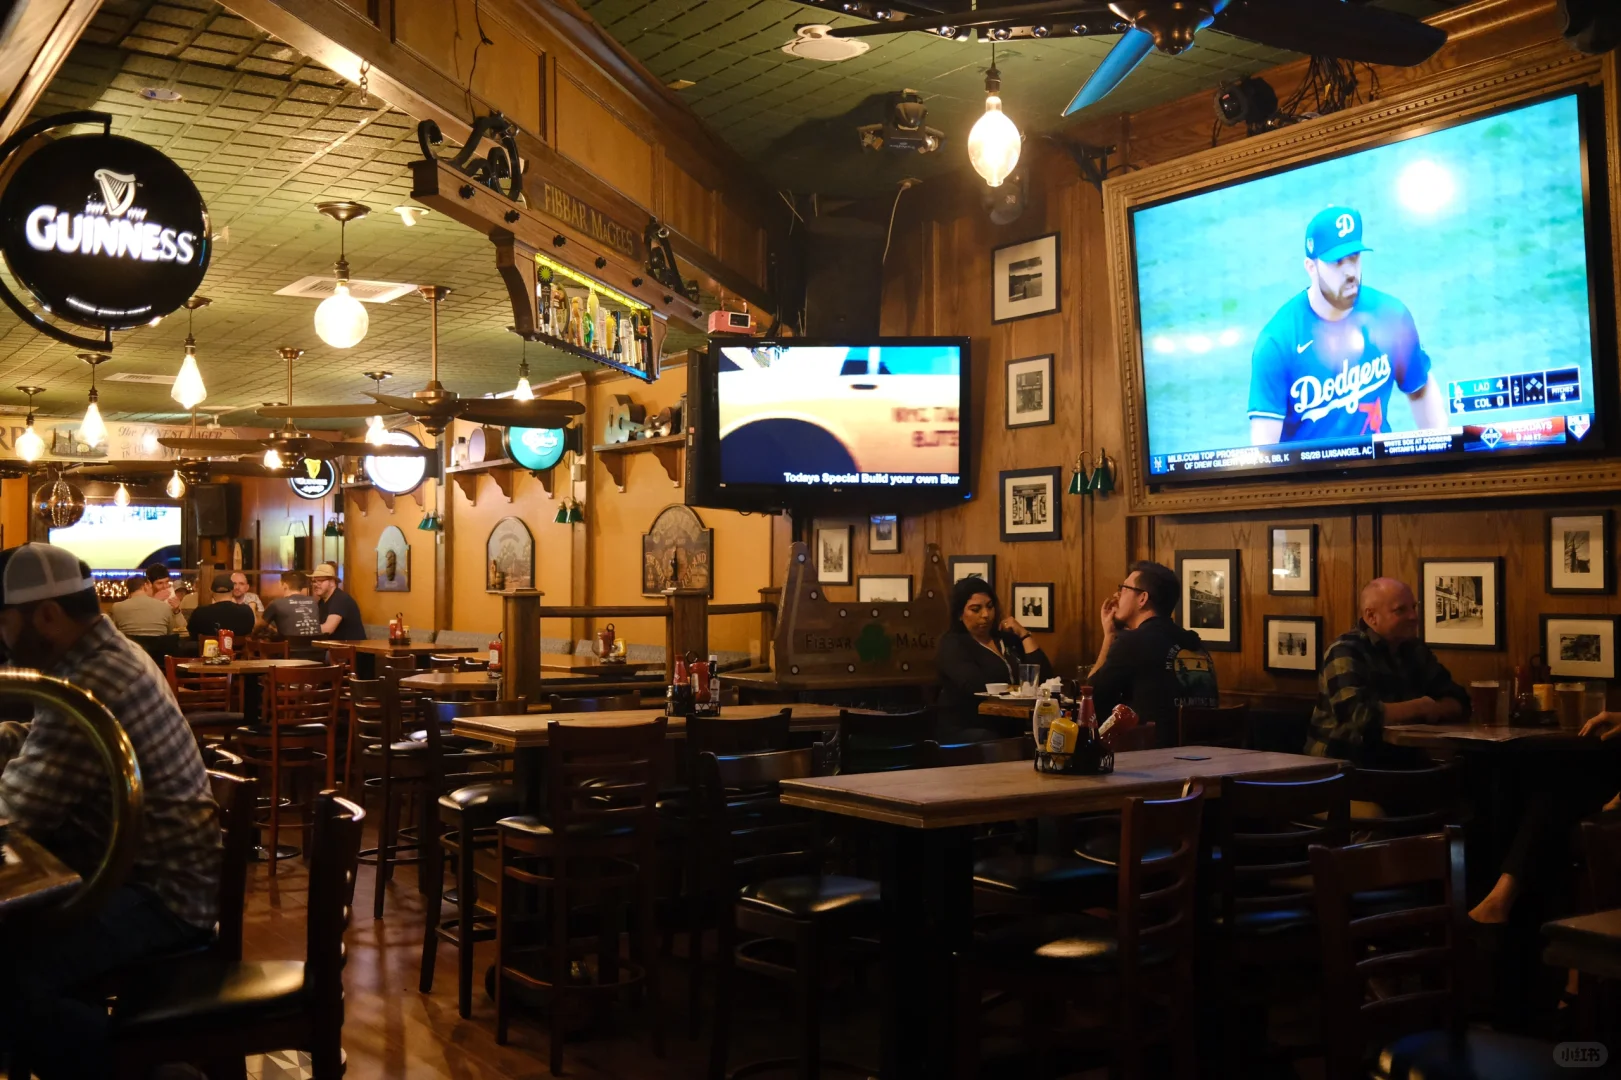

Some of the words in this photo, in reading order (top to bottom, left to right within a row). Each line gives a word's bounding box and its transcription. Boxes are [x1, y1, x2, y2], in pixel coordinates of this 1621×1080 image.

[544, 182, 588, 232] FIBBAR
[26, 205, 195, 265] GUINNESS
[1290, 354, 1391, 414] Dodgers
[1473, 383, 1490, 393] LAD
[1496, 378, 1504, 390] 4
[1513, 386, 1520, 396] 2
[1474, 398, 1492, 409] COL
[1496, 395, 1504, 407] 0
[1167, 453, 1200, 463] MLB.COM
[1200, 451, 1215, 460] TOP
[1184, 462, 1193, 470] OF
[1194, 460, 1213, 469] DREW
[1300, 451, 1321, 460] SS/2B
[1321, 448, 1361, 459] LUISANGEL
[783, 472, 820, 486] Todays
[821, 472, 859, 485] Special
[861, 472, 889, 484] Build
[890, 474, 915, 486] your
[915, 475, 938, 484] own
